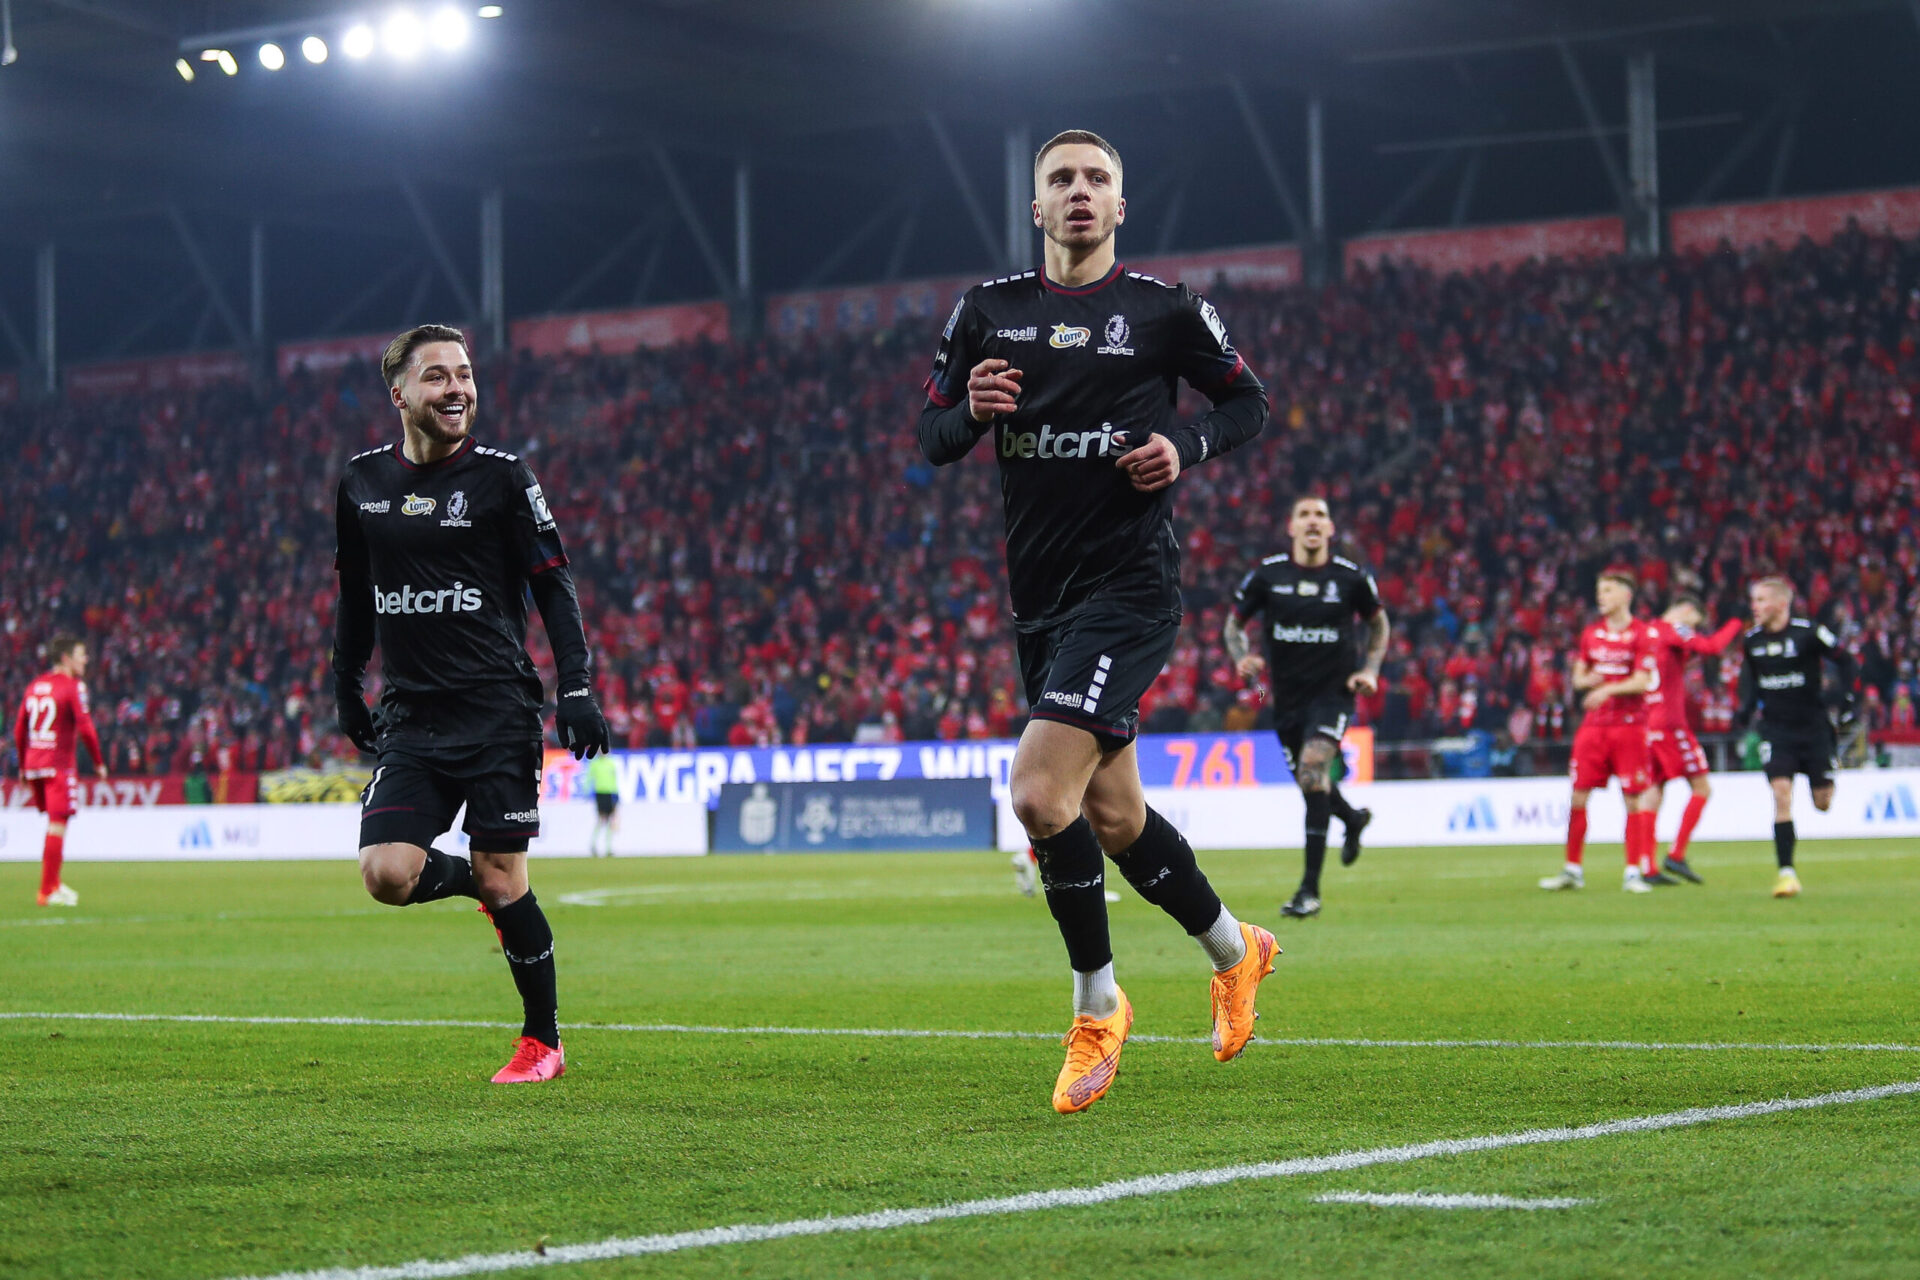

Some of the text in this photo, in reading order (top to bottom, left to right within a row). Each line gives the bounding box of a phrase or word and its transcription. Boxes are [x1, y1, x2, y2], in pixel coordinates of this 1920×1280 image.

[997, 327, 1037, 340] capelli
[1002, 422, 1133, 459] betcris
[360, 500, 391, 513] capelli
[374, 581, 482, 614] betcris
[1044, 691, 1083, 706] capelli
[26, 695, 57, 740] 22
[1165, 739, 1259, 789] 7.61
[504, 808, 538, 821] capelli
